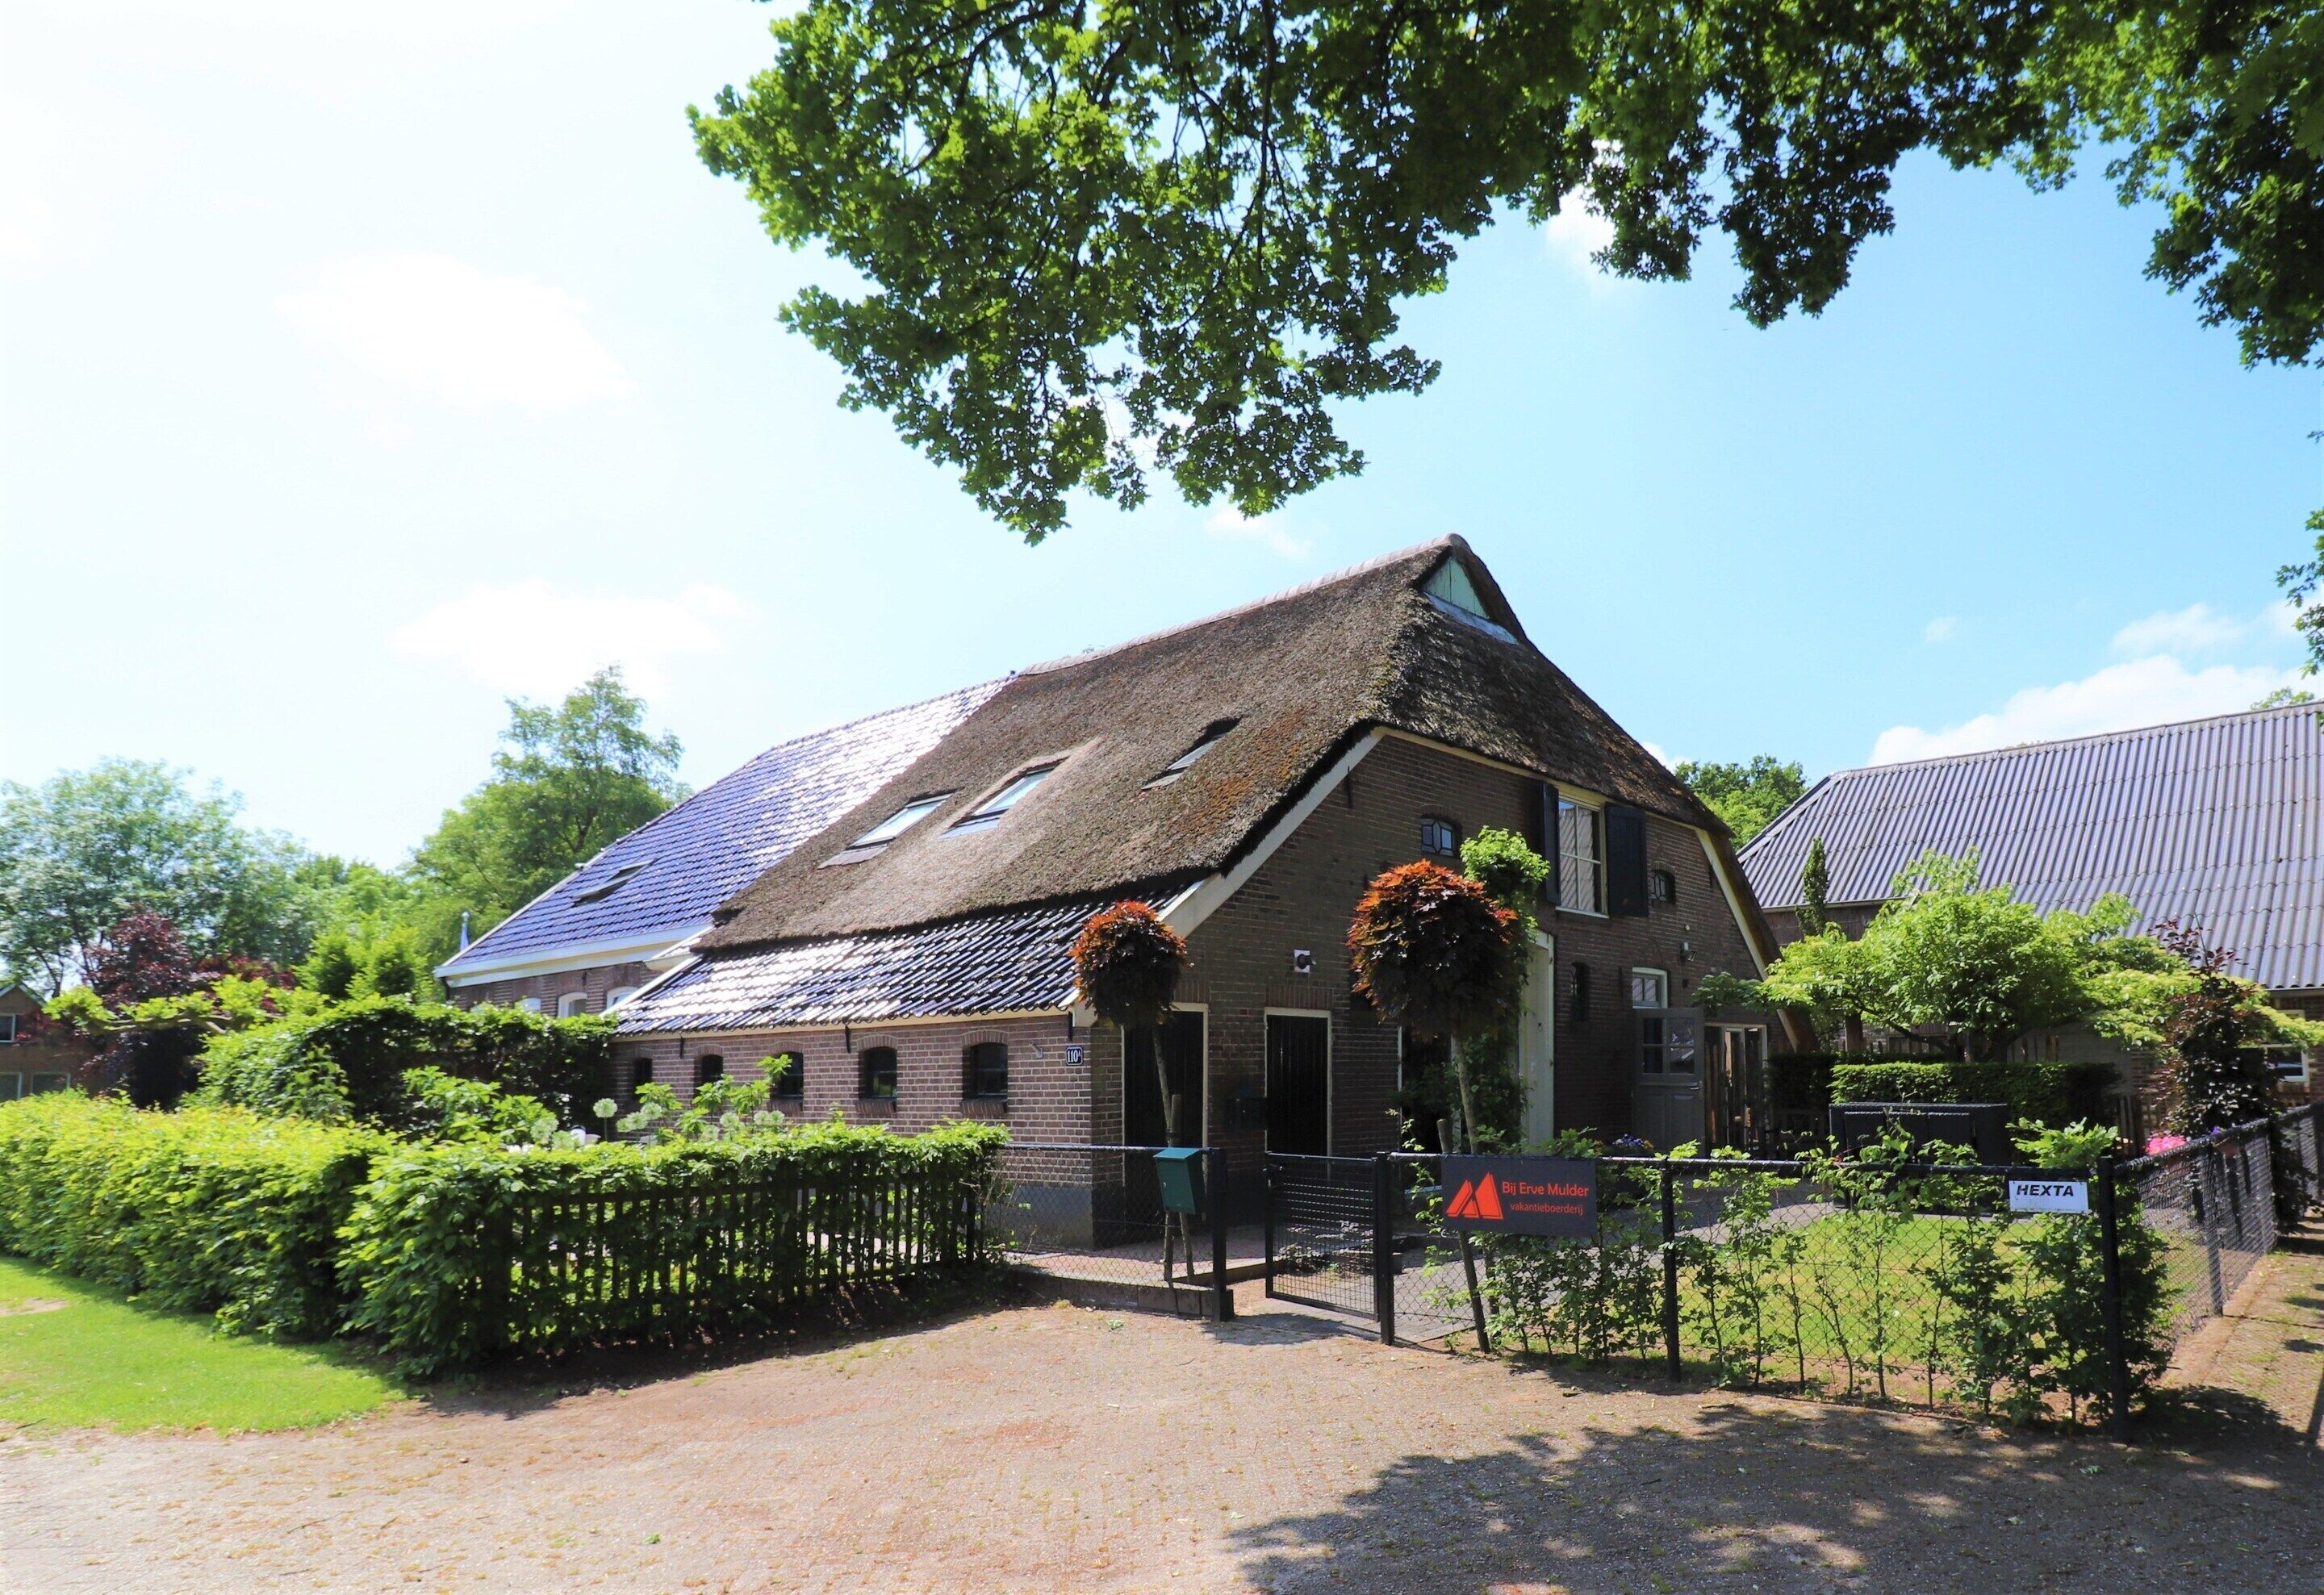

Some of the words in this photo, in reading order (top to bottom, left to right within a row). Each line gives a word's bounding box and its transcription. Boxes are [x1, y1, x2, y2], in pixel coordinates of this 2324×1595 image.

[1503, 1181, 1516, 1196] Bij
[1519, 1182, 1544, 1195] Erve
[1548, 1183, 1589, 1196] Mulder
[2017, 1184, 2074, 1196] HEXTA
[1511, 1201, 1583, 1216] vakantieboerderij
